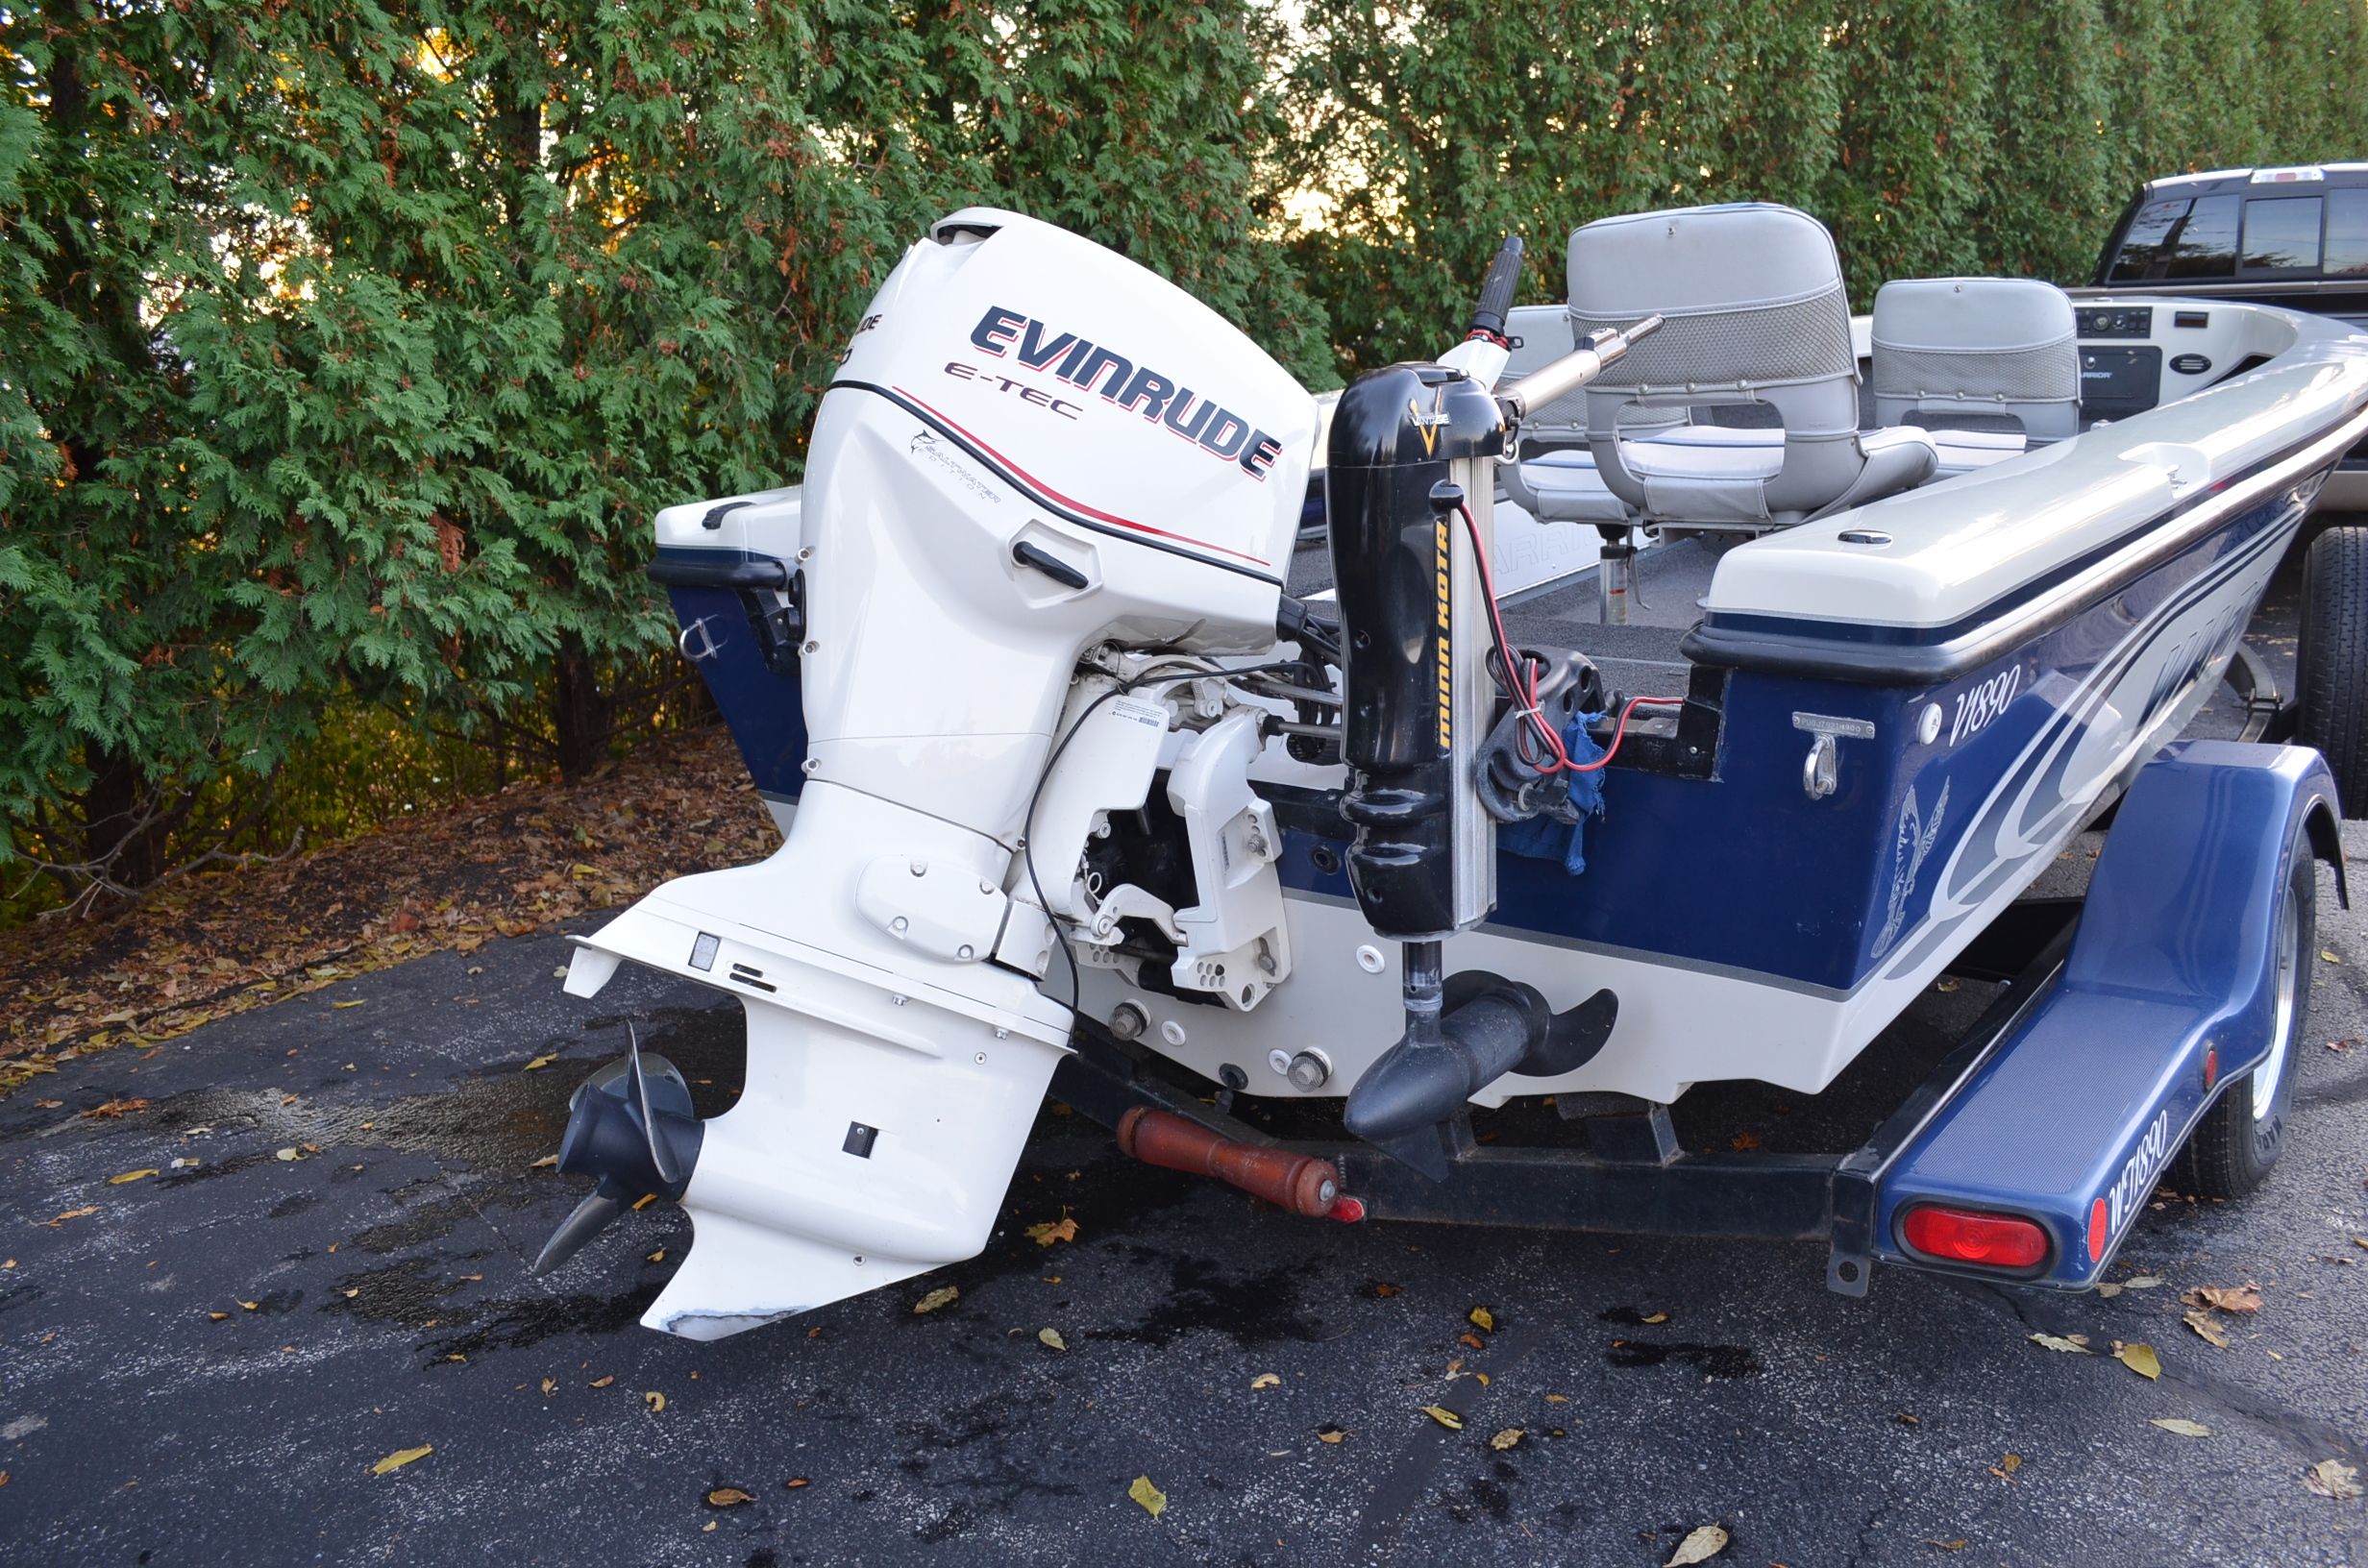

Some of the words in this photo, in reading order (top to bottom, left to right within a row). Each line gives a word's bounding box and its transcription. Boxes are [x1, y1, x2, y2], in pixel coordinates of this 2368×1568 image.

[944, 361, 1083, 421] E-TEC
[970, 305, 1282, 482] EVINRUDE
[1436, 521, 1449, 630] KOTA
[1948, 664, 2021, 747] V1890
[2109, 1110, 2168, 1237] WT1890
